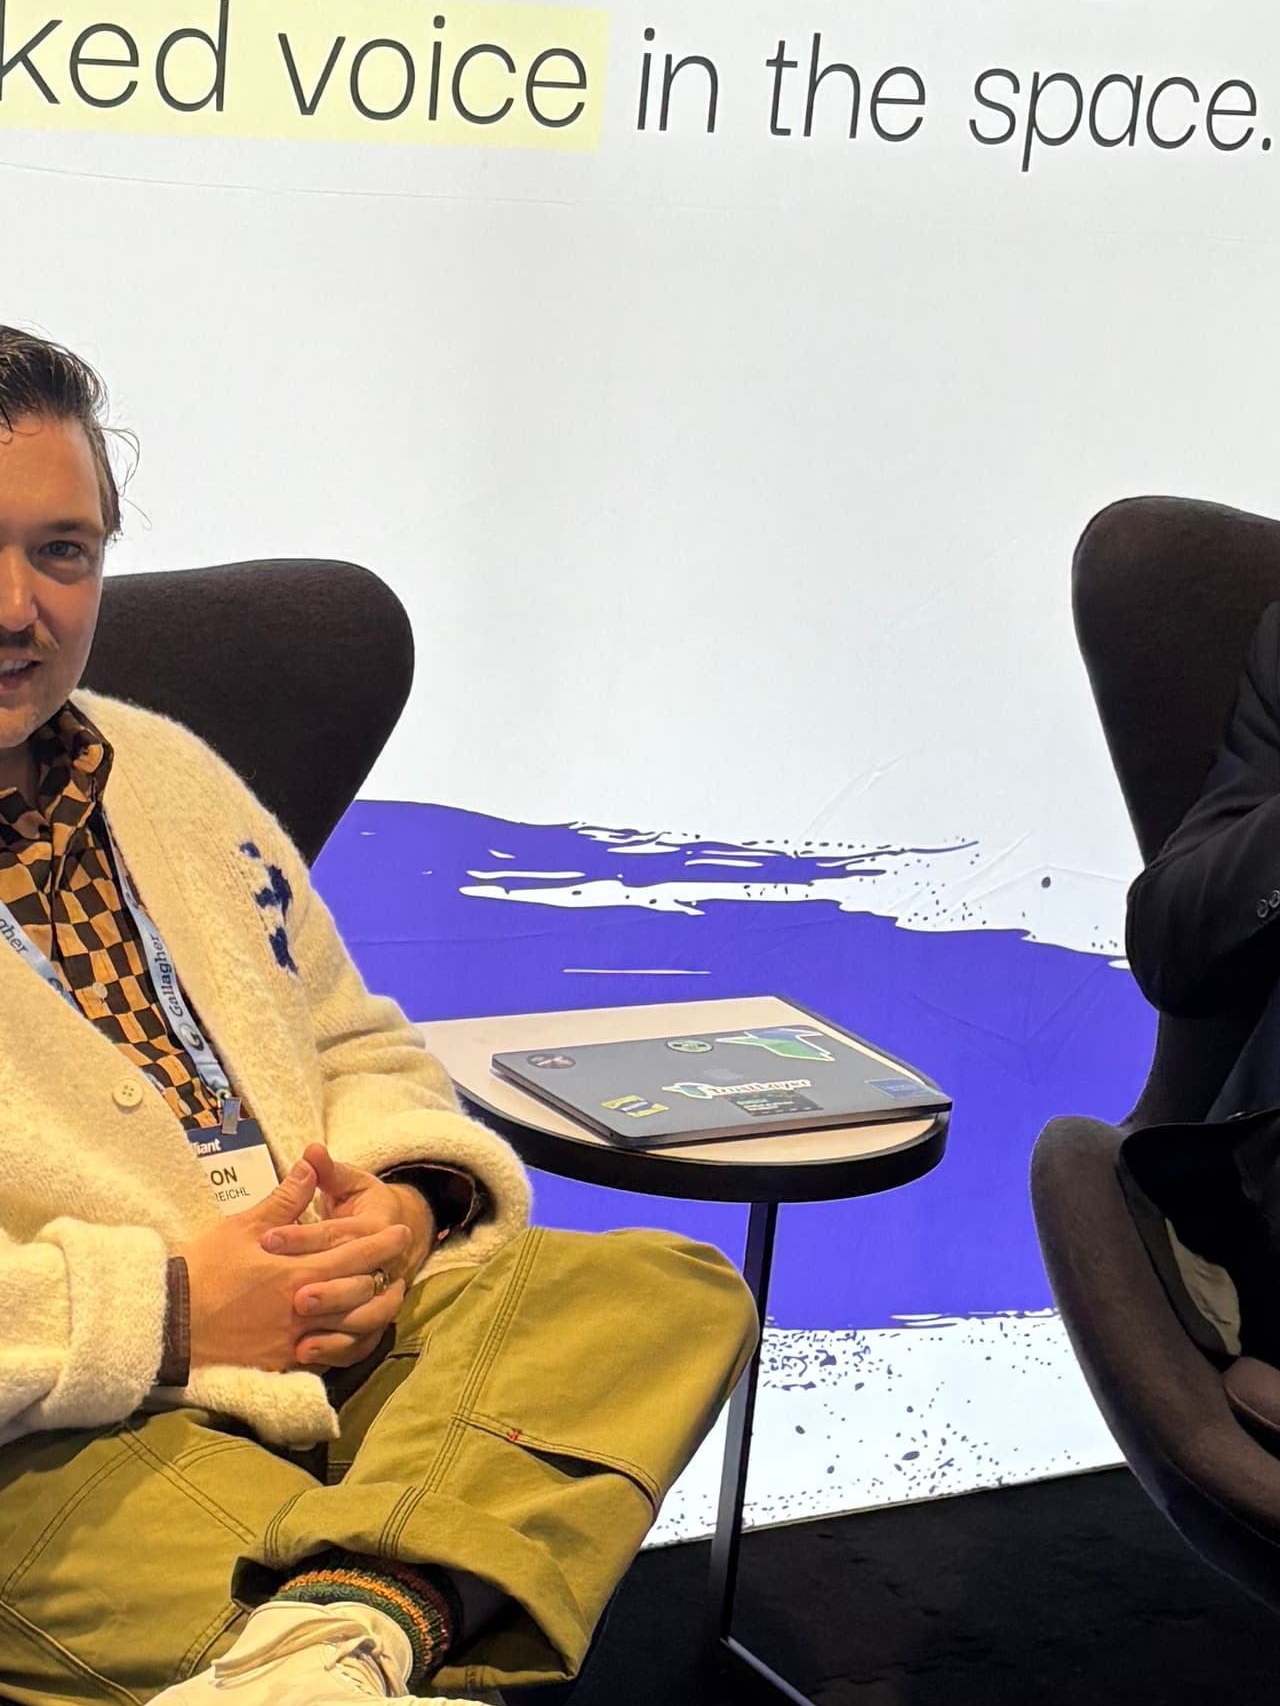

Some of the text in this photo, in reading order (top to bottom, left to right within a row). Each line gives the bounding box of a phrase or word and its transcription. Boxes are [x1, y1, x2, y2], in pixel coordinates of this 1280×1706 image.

[277, 16, 587, 128] voice
[637, 31, 719, 134] in
[765, 32, 926, 145] the
[969, 66, 1275, 173] space.
[147, 933, 185, 1017] Gallagher
